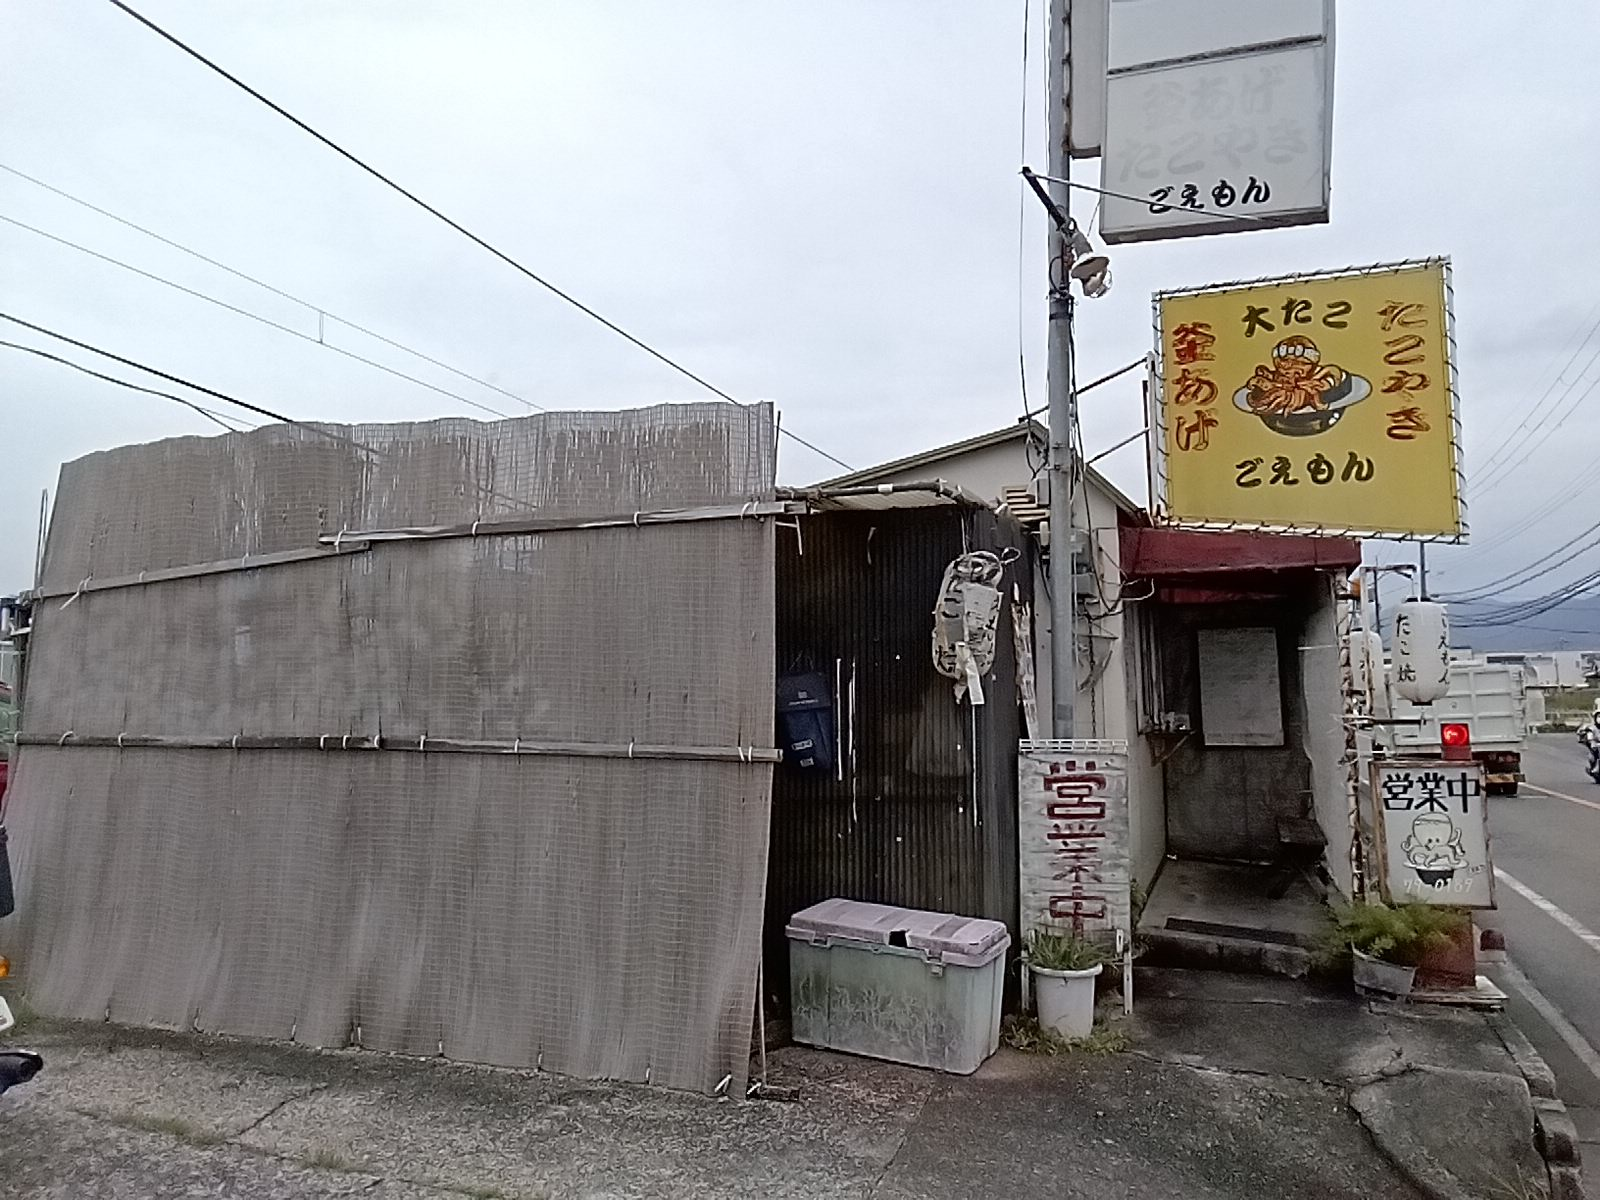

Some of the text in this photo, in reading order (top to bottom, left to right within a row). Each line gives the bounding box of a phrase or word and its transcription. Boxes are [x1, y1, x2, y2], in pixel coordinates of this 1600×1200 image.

[1149, 176, 1271, 214] ごえもん
[1242, 297, 1352, 338] 大たこ
[1172, 321, 1219, 451] 釜あげ
[1376, 299, 1431, 440] たこやき
[1235, 451, 1375, 487] ごえもん
[1396, 613, 1417, 682] たこ焼
[1382, 772, 1481, 813] 営業中
[1044, 760, 1107, 940] 営業中
